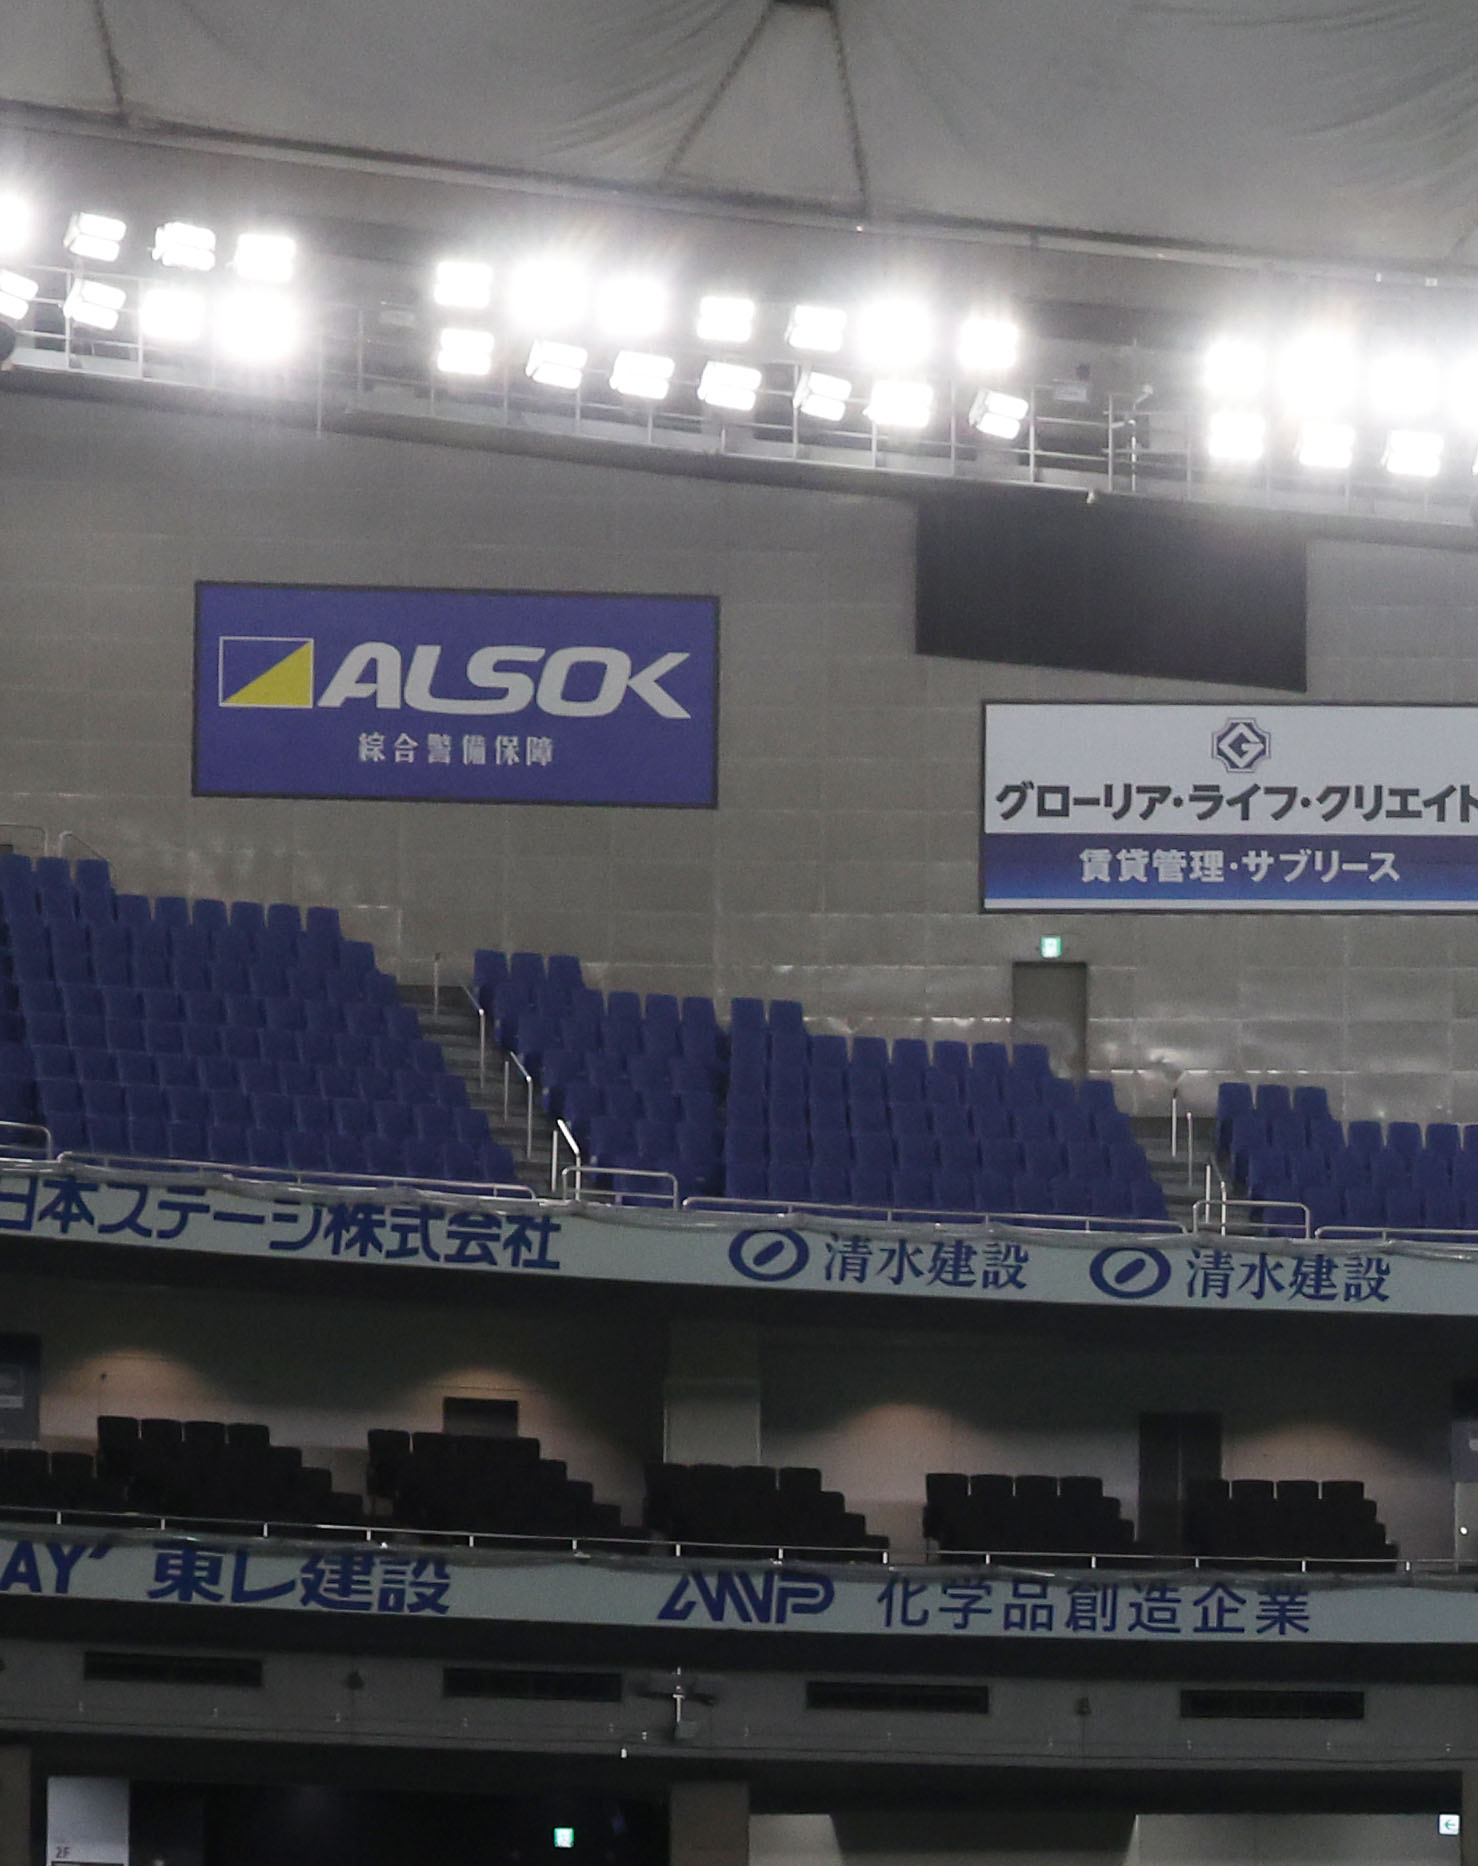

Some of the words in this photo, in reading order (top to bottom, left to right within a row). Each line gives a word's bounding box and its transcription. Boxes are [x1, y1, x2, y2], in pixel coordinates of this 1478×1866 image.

[318, 642, 691, 719] ALSOK
[358, 733, 555, 767] 綜合警備保障
[1079, 848, 1400, 884] 賃貸管理・サブリース
[824, 1232, 1031, 1292] 清水建設
[1185, 1246, 1392, 1303] 清水建設
[146, 1544, 452, 1616] 東レ建設
[877, 1578, 1312, 1636] 化学品創造企業
